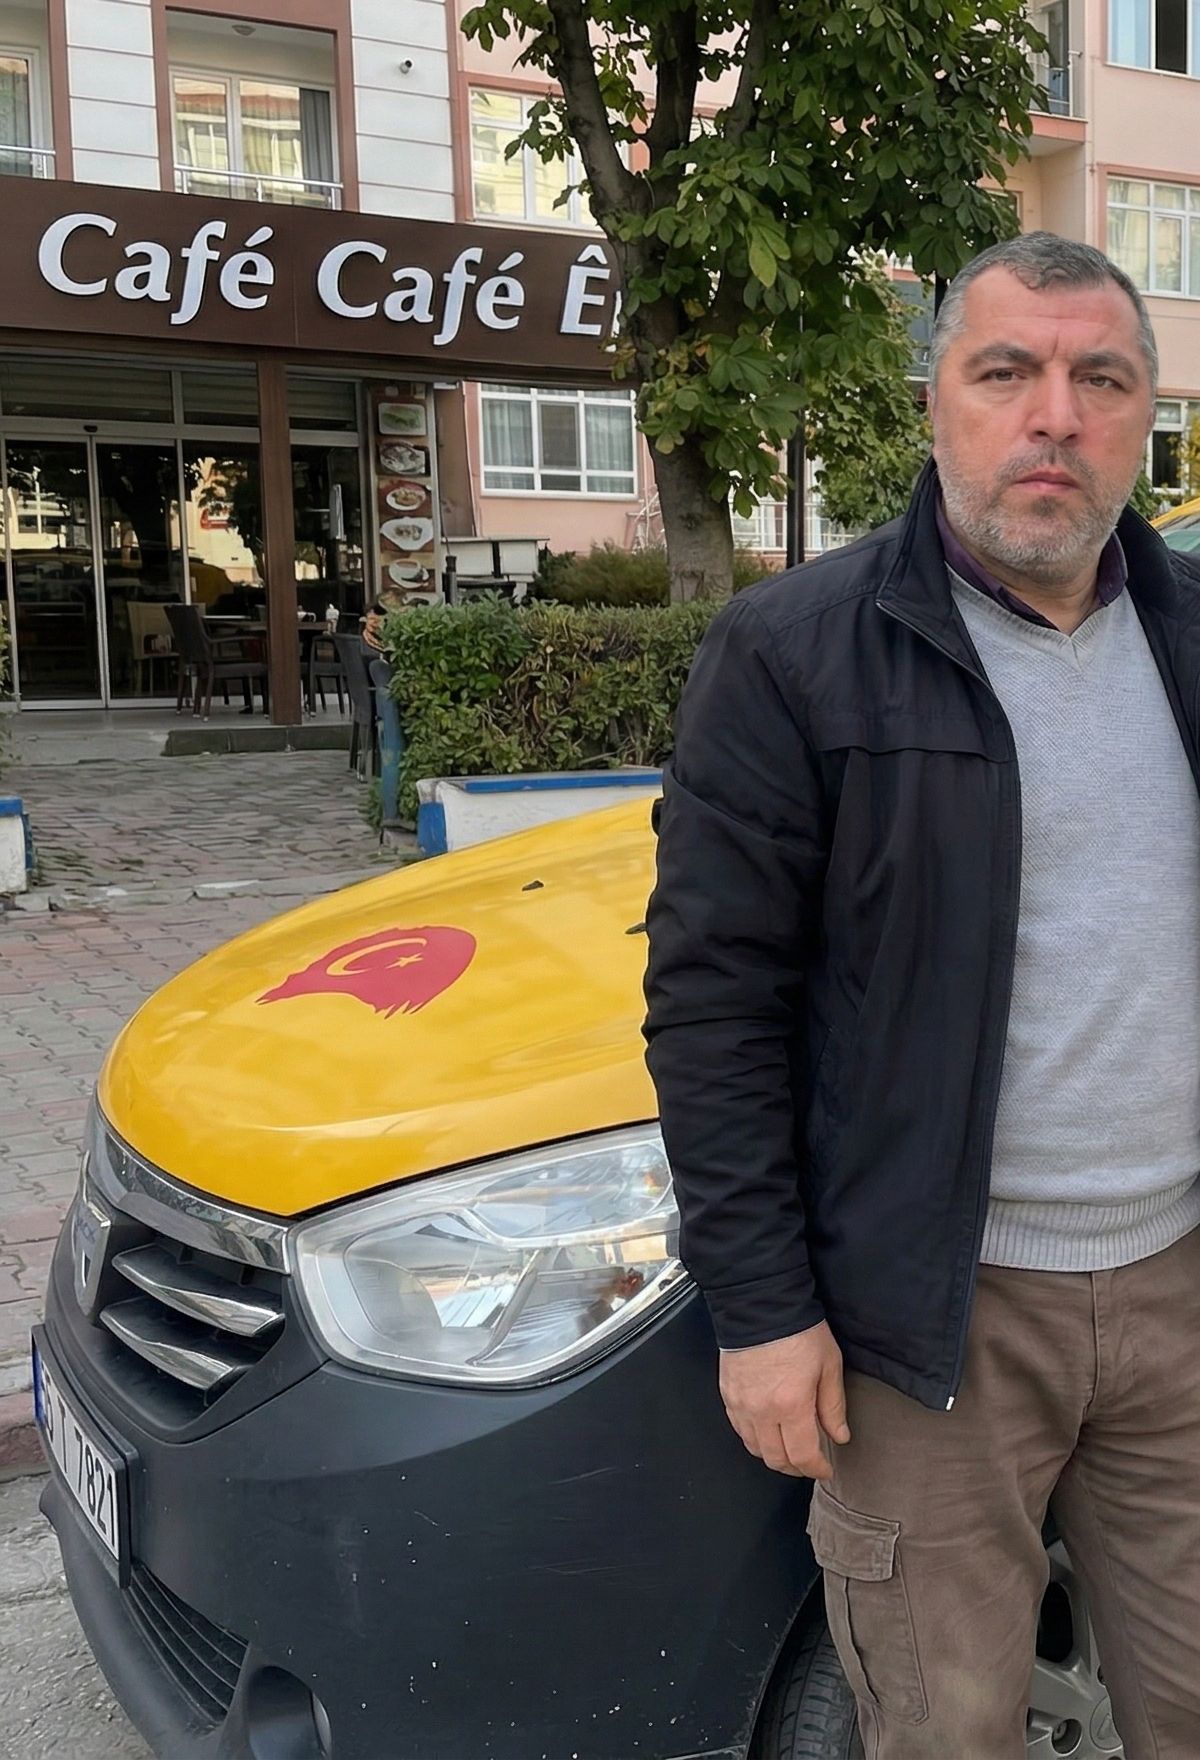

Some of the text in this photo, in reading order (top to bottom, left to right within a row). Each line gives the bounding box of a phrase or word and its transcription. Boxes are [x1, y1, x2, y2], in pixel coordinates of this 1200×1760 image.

[38, 213, 274, 326] Café
[317, 240, 525, 346] Café
[74, 1425, 115, 1548] 7821
